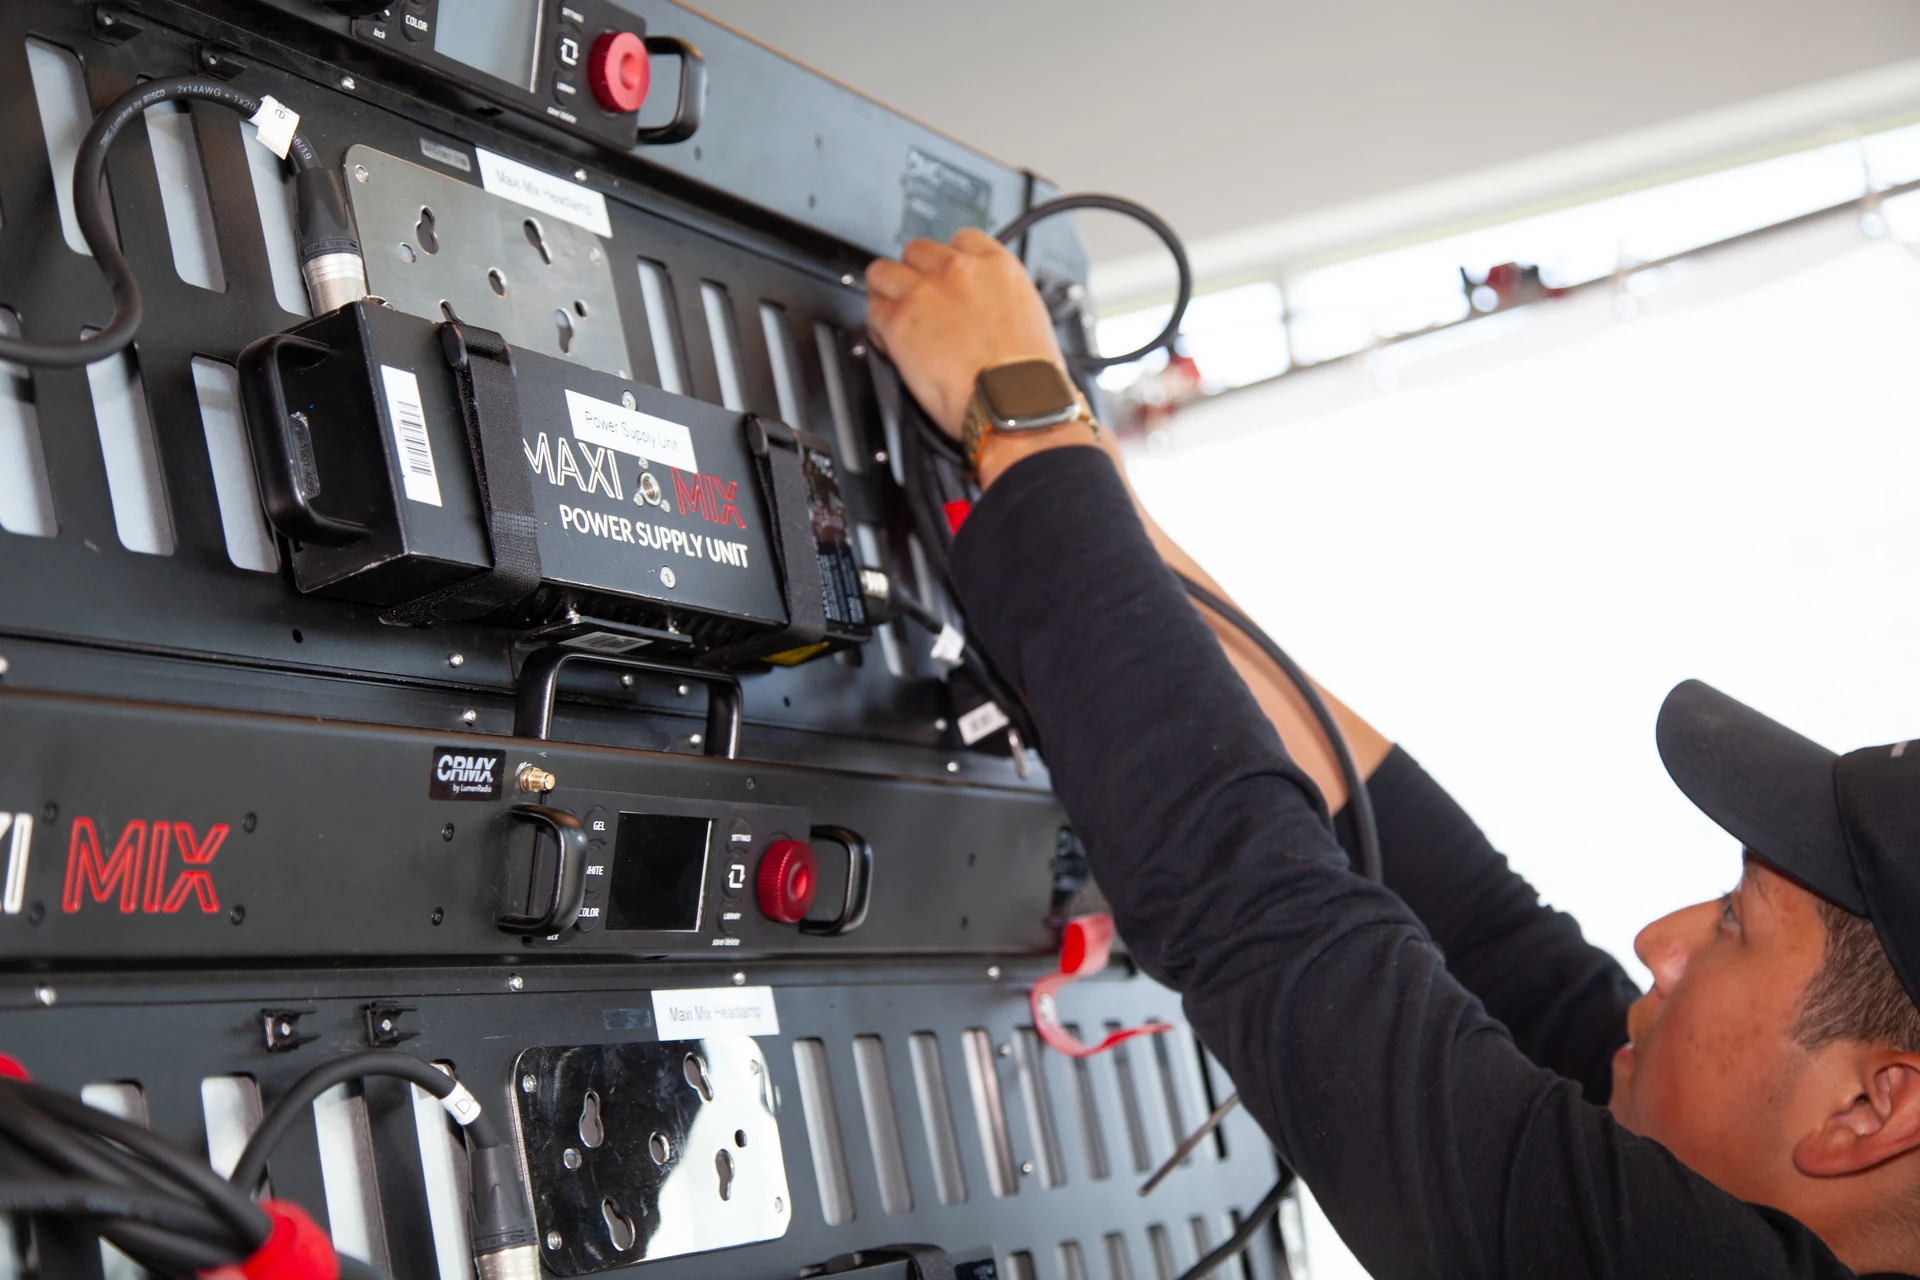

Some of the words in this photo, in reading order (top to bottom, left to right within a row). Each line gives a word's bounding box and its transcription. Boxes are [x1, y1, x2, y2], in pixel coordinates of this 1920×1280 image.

[405, 14, 428, 32] COLOR
[373, 27, 387, 39] lock
[176, 85, 221, 97] 2x14AWG
[585, 410, 618, 433] Power
[620, 421, 656, 448] Supply
[659, 433, 680, 453] Unit
[523, 432, 624, 500] MAXI
[671, 466, 747, 529] MIX
[559, 504, 635, 544] POWER
[635, 521, 703, 559] SUPPLY
[707, 537, 749, 568] UNIT
[437, 754, 497, 782] CRMX
[453, 784, 460, 793] by
[460, 784, 493, 793] LumenRadio
[592, 821, 606, 831] GEL
[62, 816, 230, 914] MIX
[586, 866, 604, 875] HITE
[669, 1007, 692, 1022] Maxi
[694, 1006, 711, 1021] Mix
